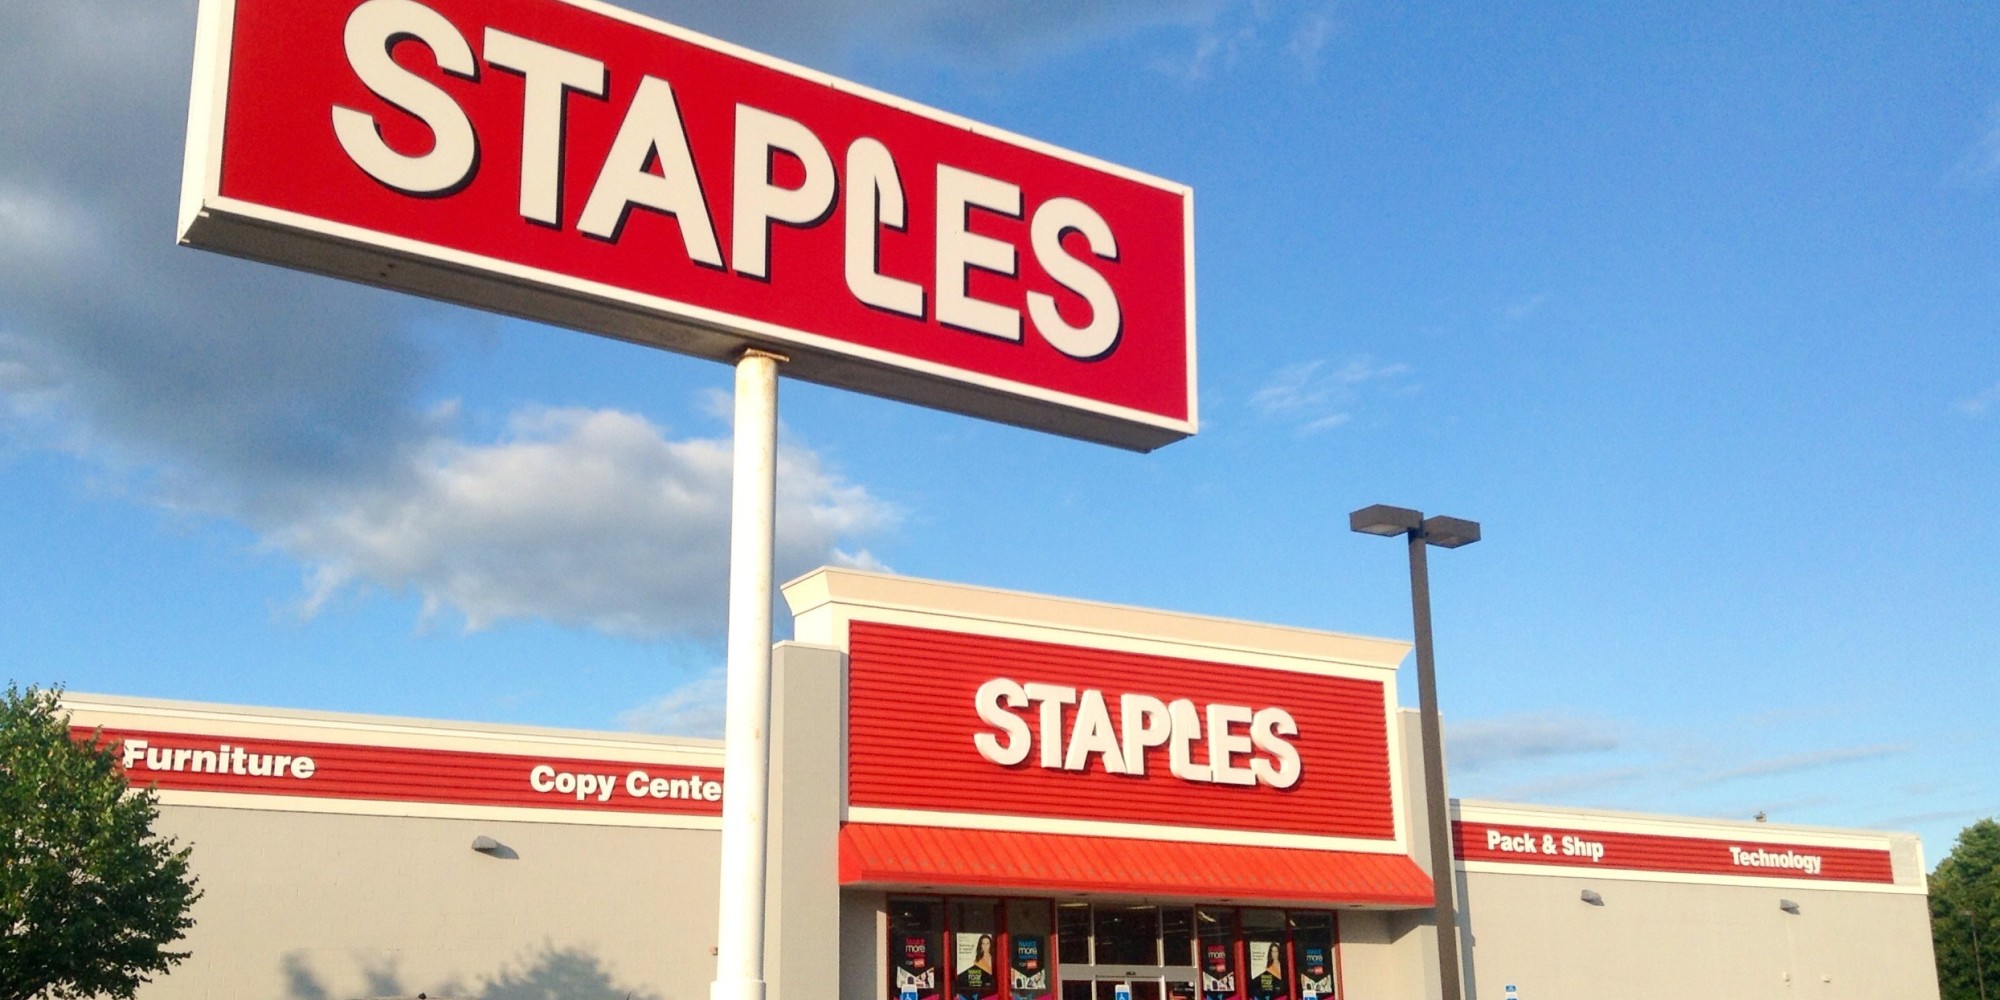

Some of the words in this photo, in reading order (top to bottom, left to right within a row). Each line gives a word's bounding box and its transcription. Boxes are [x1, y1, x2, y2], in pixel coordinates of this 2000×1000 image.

[332, 0, 1122, 362] STAPLES
[973, 677, 1301, 788] STAPLES
[123, 739, 316, 779] Furniture
[530, 765, 616, 801] Copy
[625, 770, 724, 801] Cente
[1486, 829, 1537, 853] Pack
[1542, 834, 1558, 854] &
[1562, 835, 1604, 862] Ship
[1729, 846, 1821, 874] Technology
[905, 944, 926, 953] more
[1018, 947, 1038, 955] more
